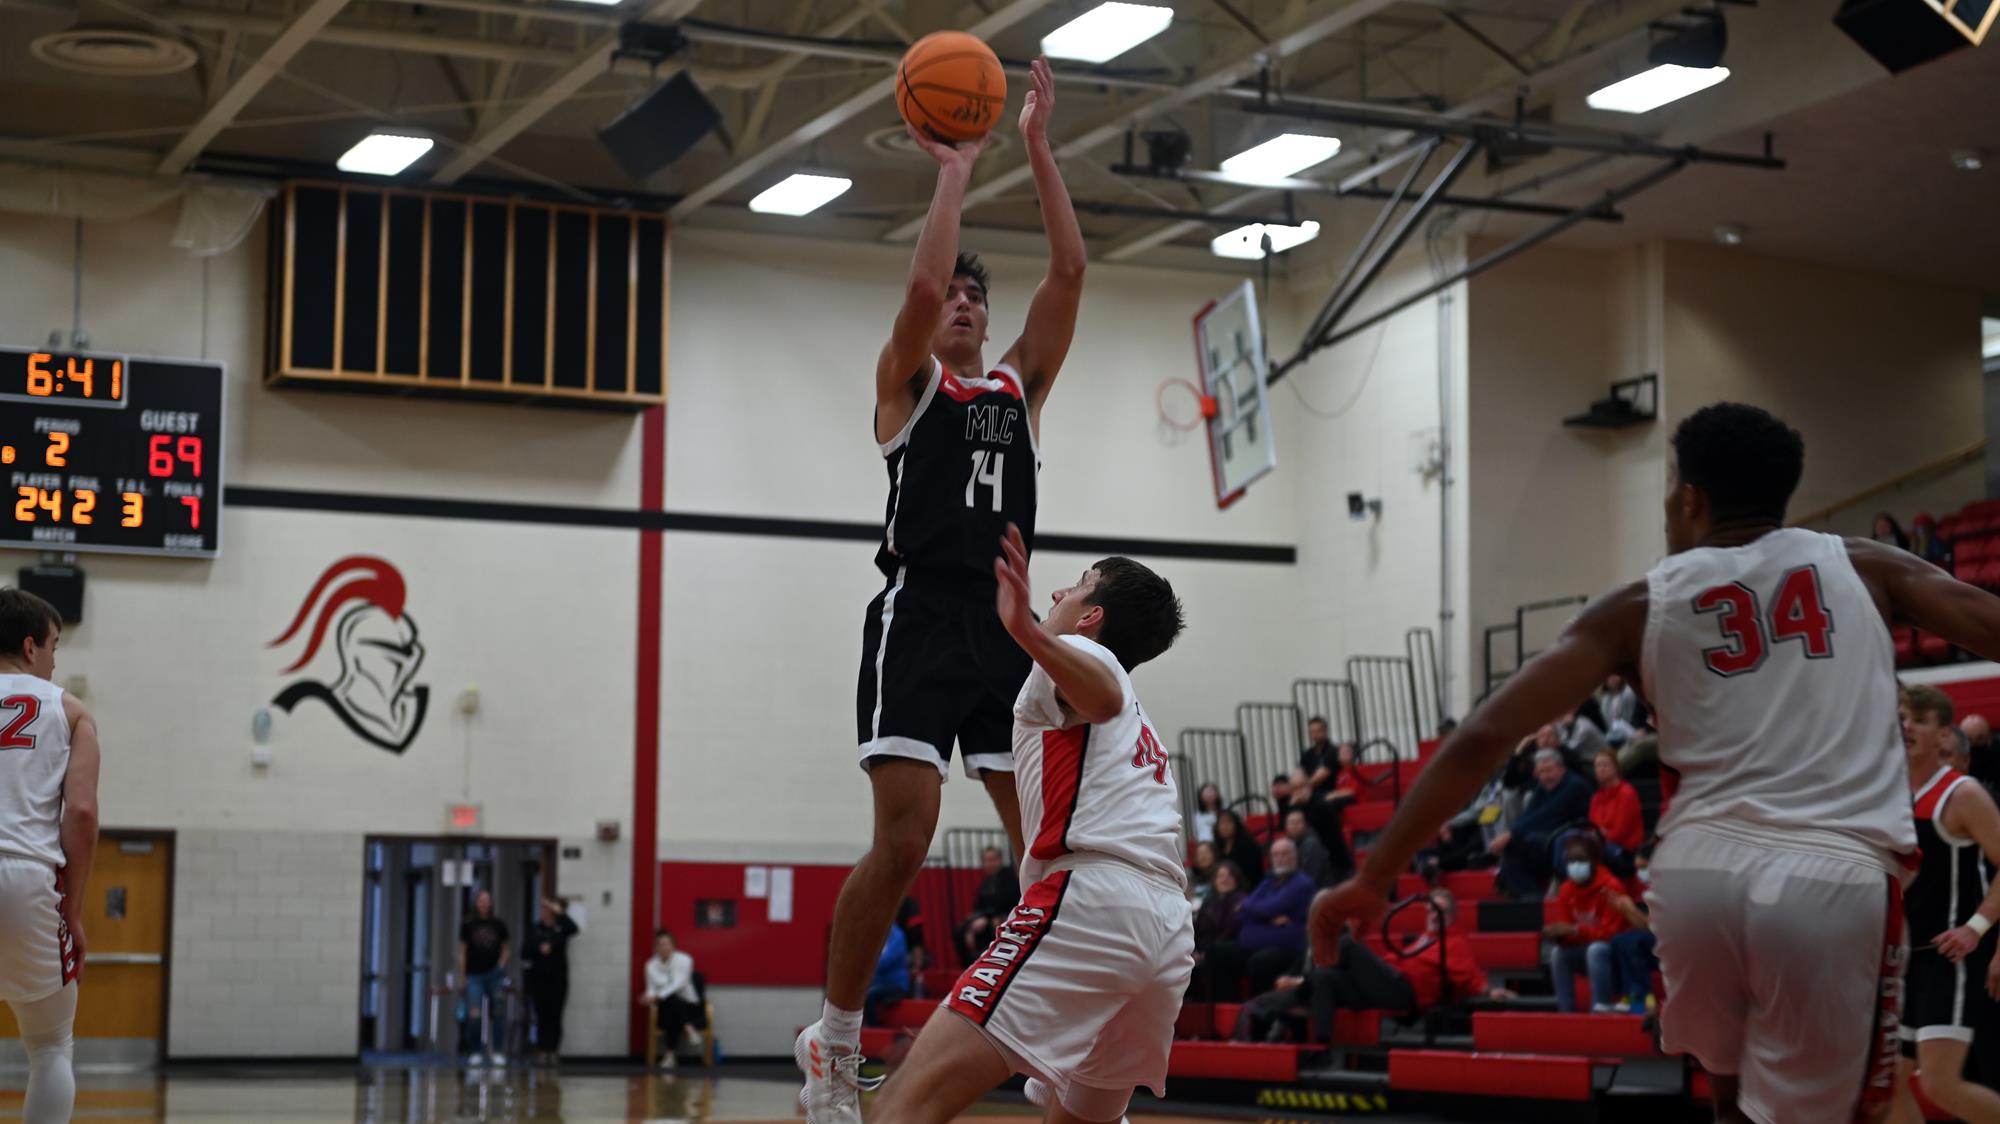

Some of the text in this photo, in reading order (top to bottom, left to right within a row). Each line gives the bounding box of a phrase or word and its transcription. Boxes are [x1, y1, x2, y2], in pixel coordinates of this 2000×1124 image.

[27, 353, 123, 399] 6:41
[141, 411, 199, 433] GUEST
[965, 405, 1018, 444] MLC
[46, 431, 69, 467] 2
[149, 435, 202, 477] 69
[965, 450, 1004, 512] 14
[15, 486, 61, 521] 24
[72, 489, 95, 525] 2
[121, 492, 143, 528] 3
[181, 496, 200, 529] 7
[1691, 564, 1836, 678] 34
